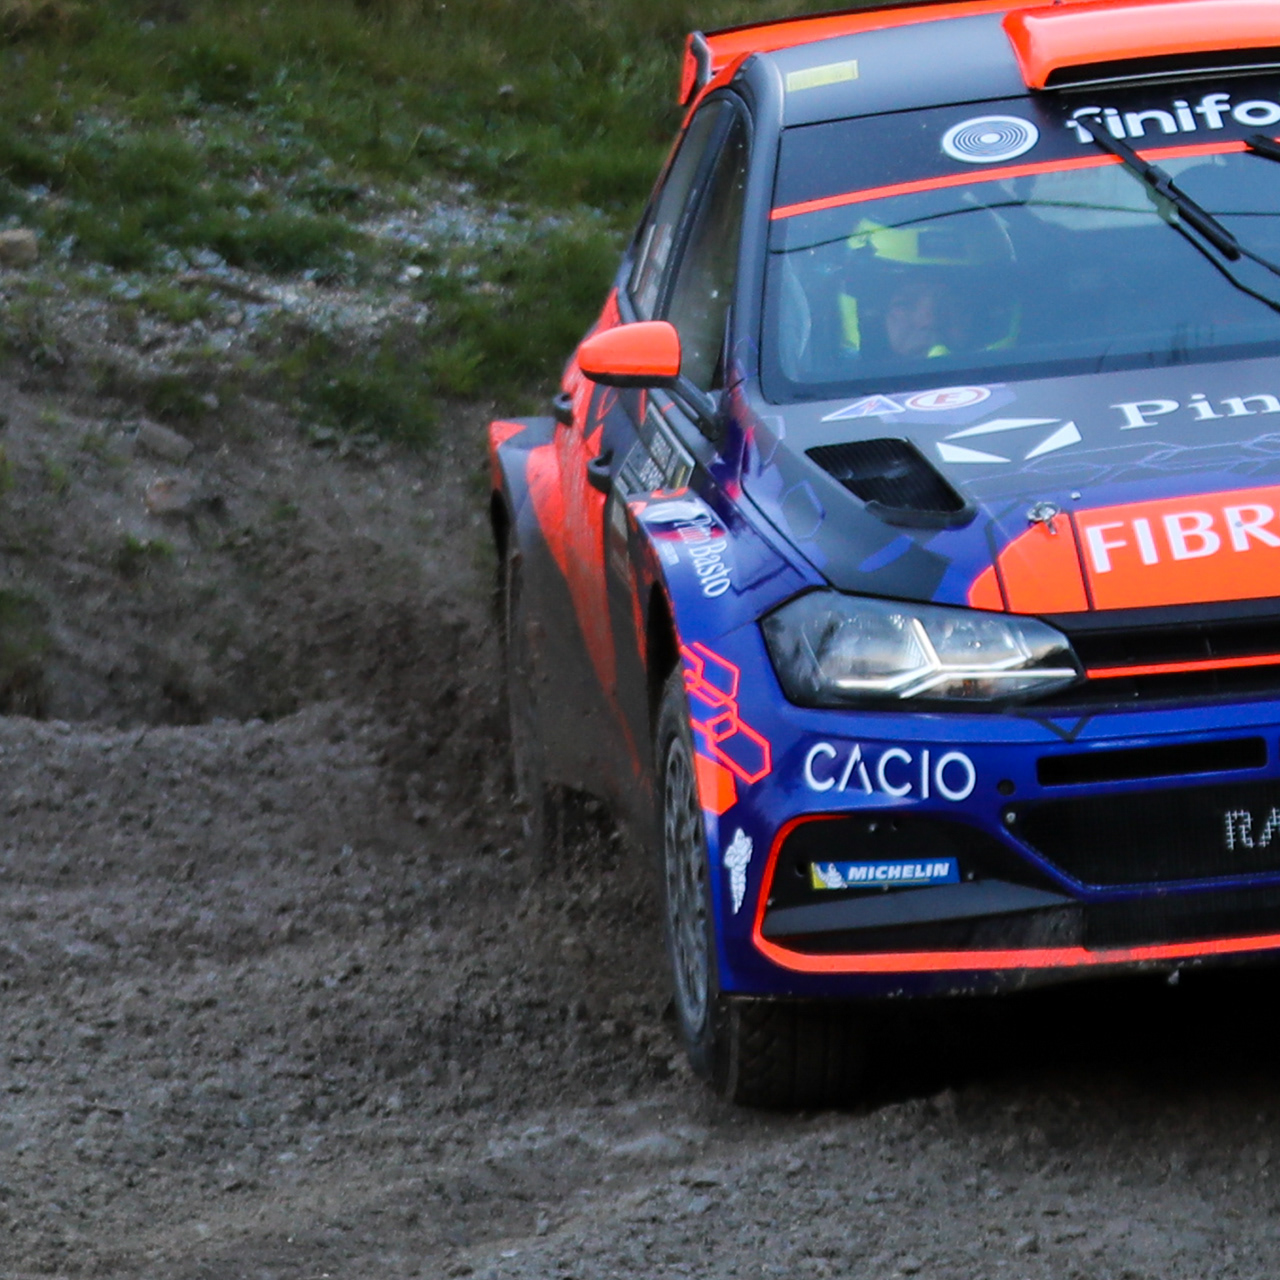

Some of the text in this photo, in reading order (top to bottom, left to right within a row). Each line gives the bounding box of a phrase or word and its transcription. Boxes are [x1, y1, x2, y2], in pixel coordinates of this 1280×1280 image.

[689, 540, 733, 598] Basto
[805, 742, 976, 801] CACIO
[847, 862, 950, 881] MICHELIN
